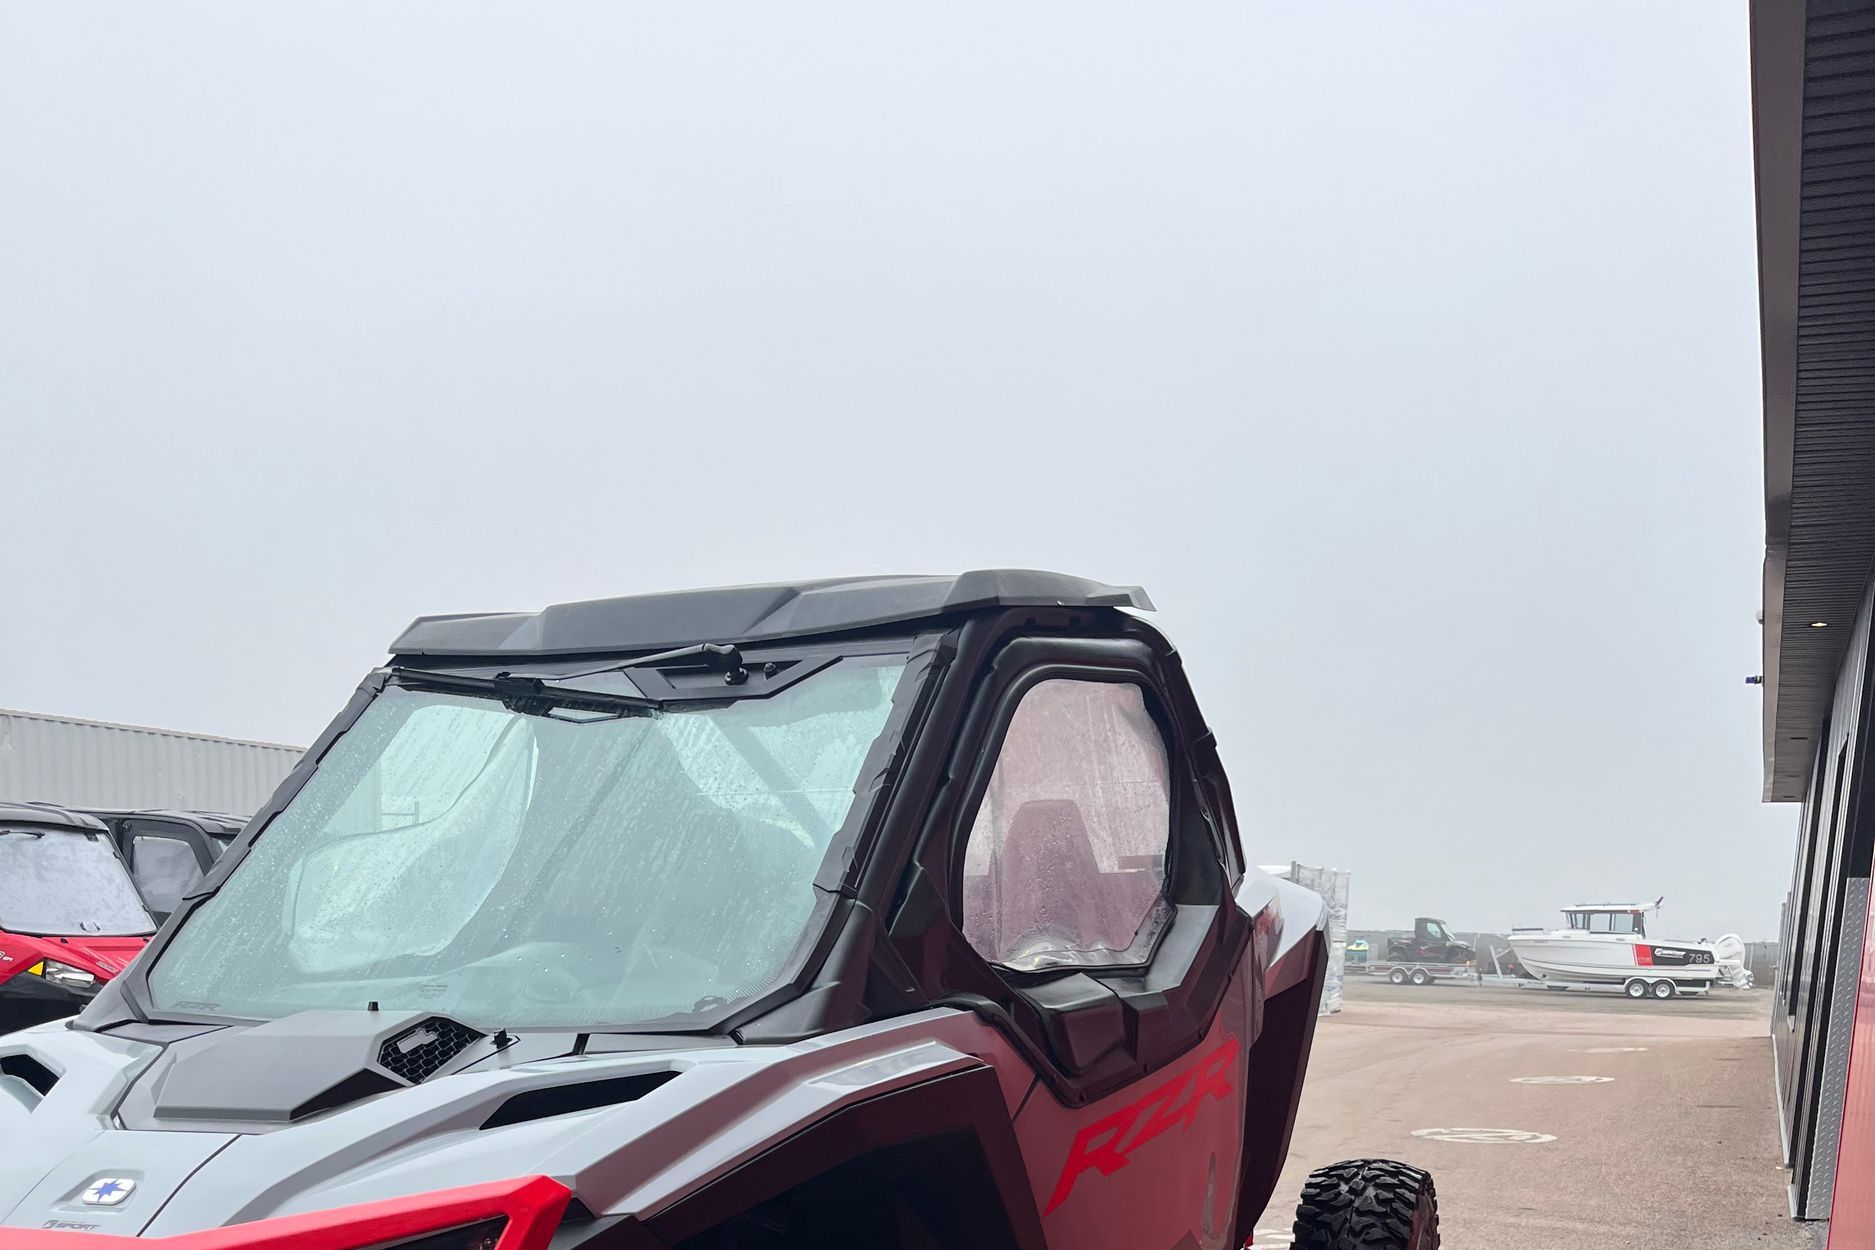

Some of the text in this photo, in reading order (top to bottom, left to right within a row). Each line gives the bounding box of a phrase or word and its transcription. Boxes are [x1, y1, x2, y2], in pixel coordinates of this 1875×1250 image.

[1689, 953, 1711, 964] 795
[1043, 1038, 1240, 1217] RZR
[55, 1221, 100, 1230] SPORT
